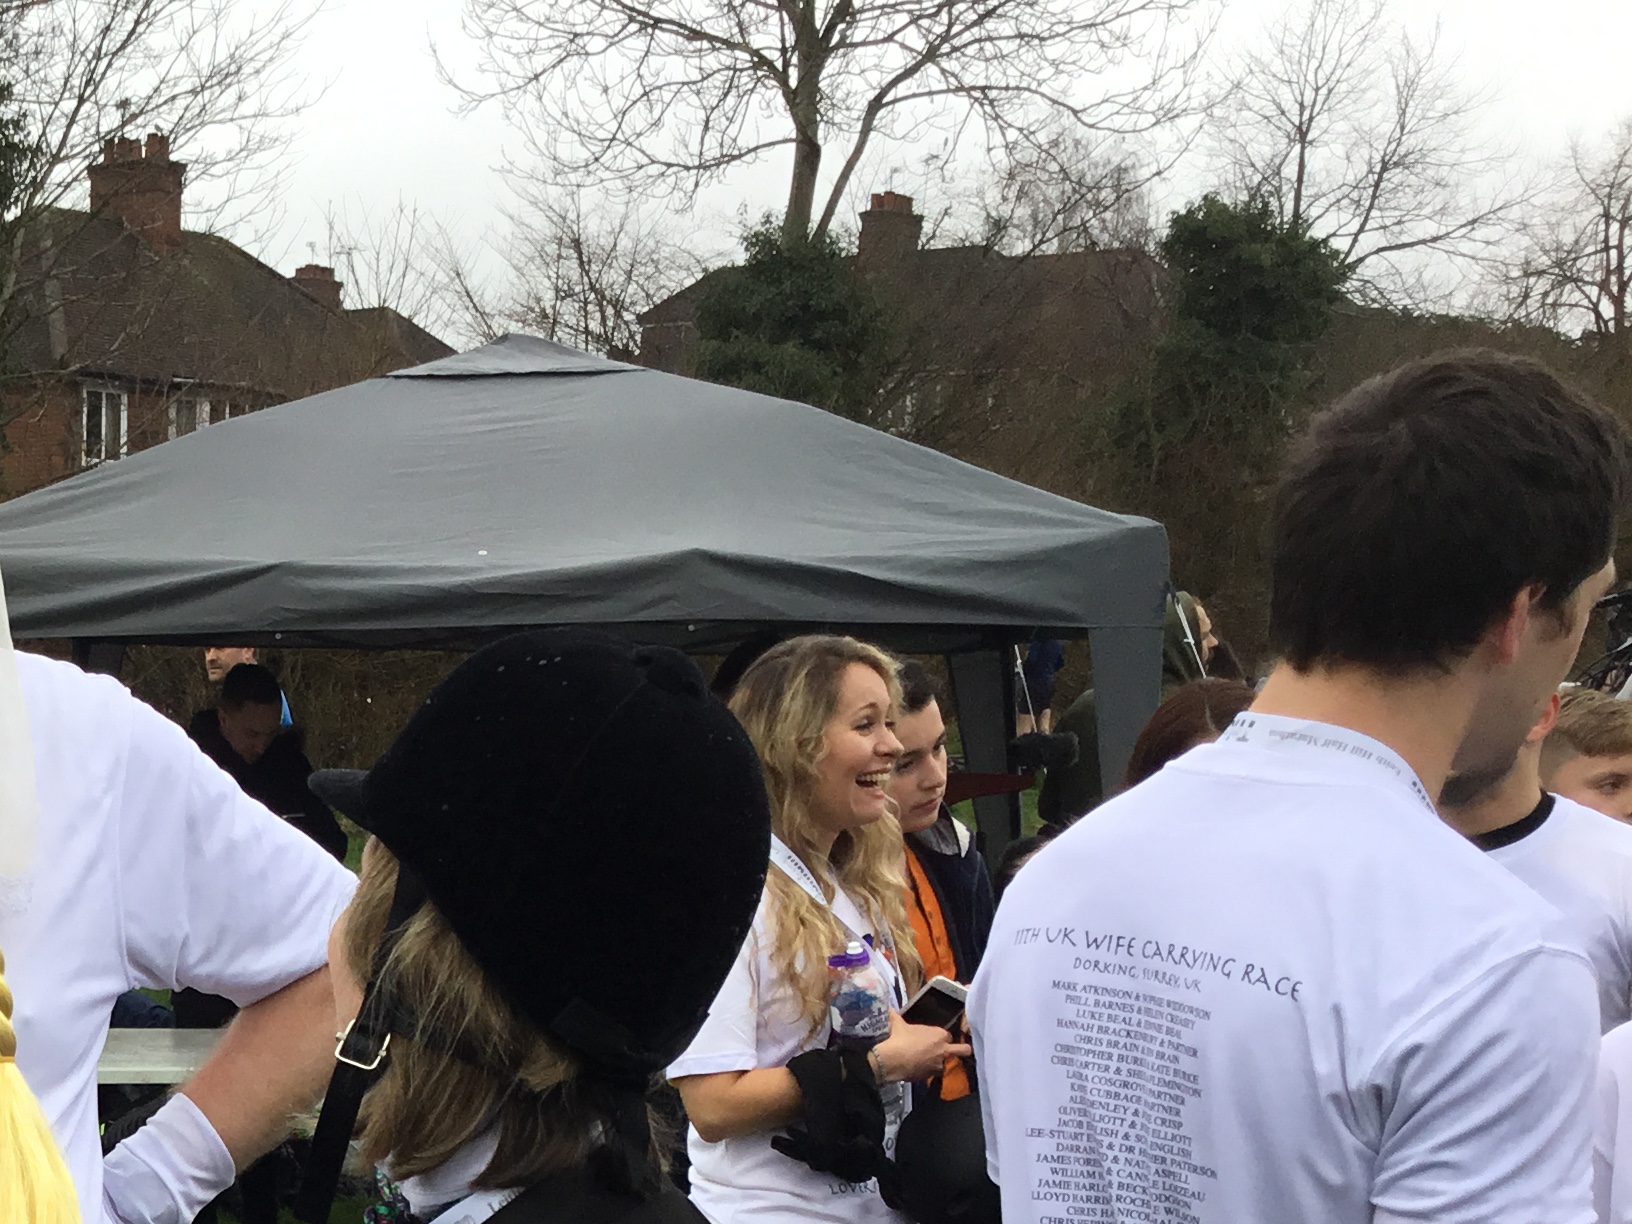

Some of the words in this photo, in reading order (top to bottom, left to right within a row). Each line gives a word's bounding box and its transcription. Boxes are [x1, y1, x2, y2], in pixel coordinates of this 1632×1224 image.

[1046, 926, 1077, 947] UK
[1085, 930, 1136, 957] WIFE
[1142, 940, 1236, 980] CARRYING
[1241, 963, 1303, 1002] RACE
[1052, 980, 1079, 992] MARK
[1080, 984, 1133, 1000] ATKINSON
[1184, 977, 1201, 993] UK
[1093, 998, 1135, 1013] BARNES
[1076, 1009, 1105, 1021] LUKE
[1106, 1013, 1134, 1027] BEAL
[1057, 1018, 1094, 1033] HANNAH
[1074, 1034, 1103, 1047] CHRIS
[1153, 1116, 1184, 1131] CRISP
[1119, 1143, 1136, 1155] DR
[1036, 1153, 1071, 1166] JAMES
[1050, 1167, 1096, 1180] WILLIAM
[1037, 1178, 1072, 1191] JAMIE
[1031, 1191, 1070, 1203] LLOYD
[1066, 1205, 1097, 1217] CHRIS
